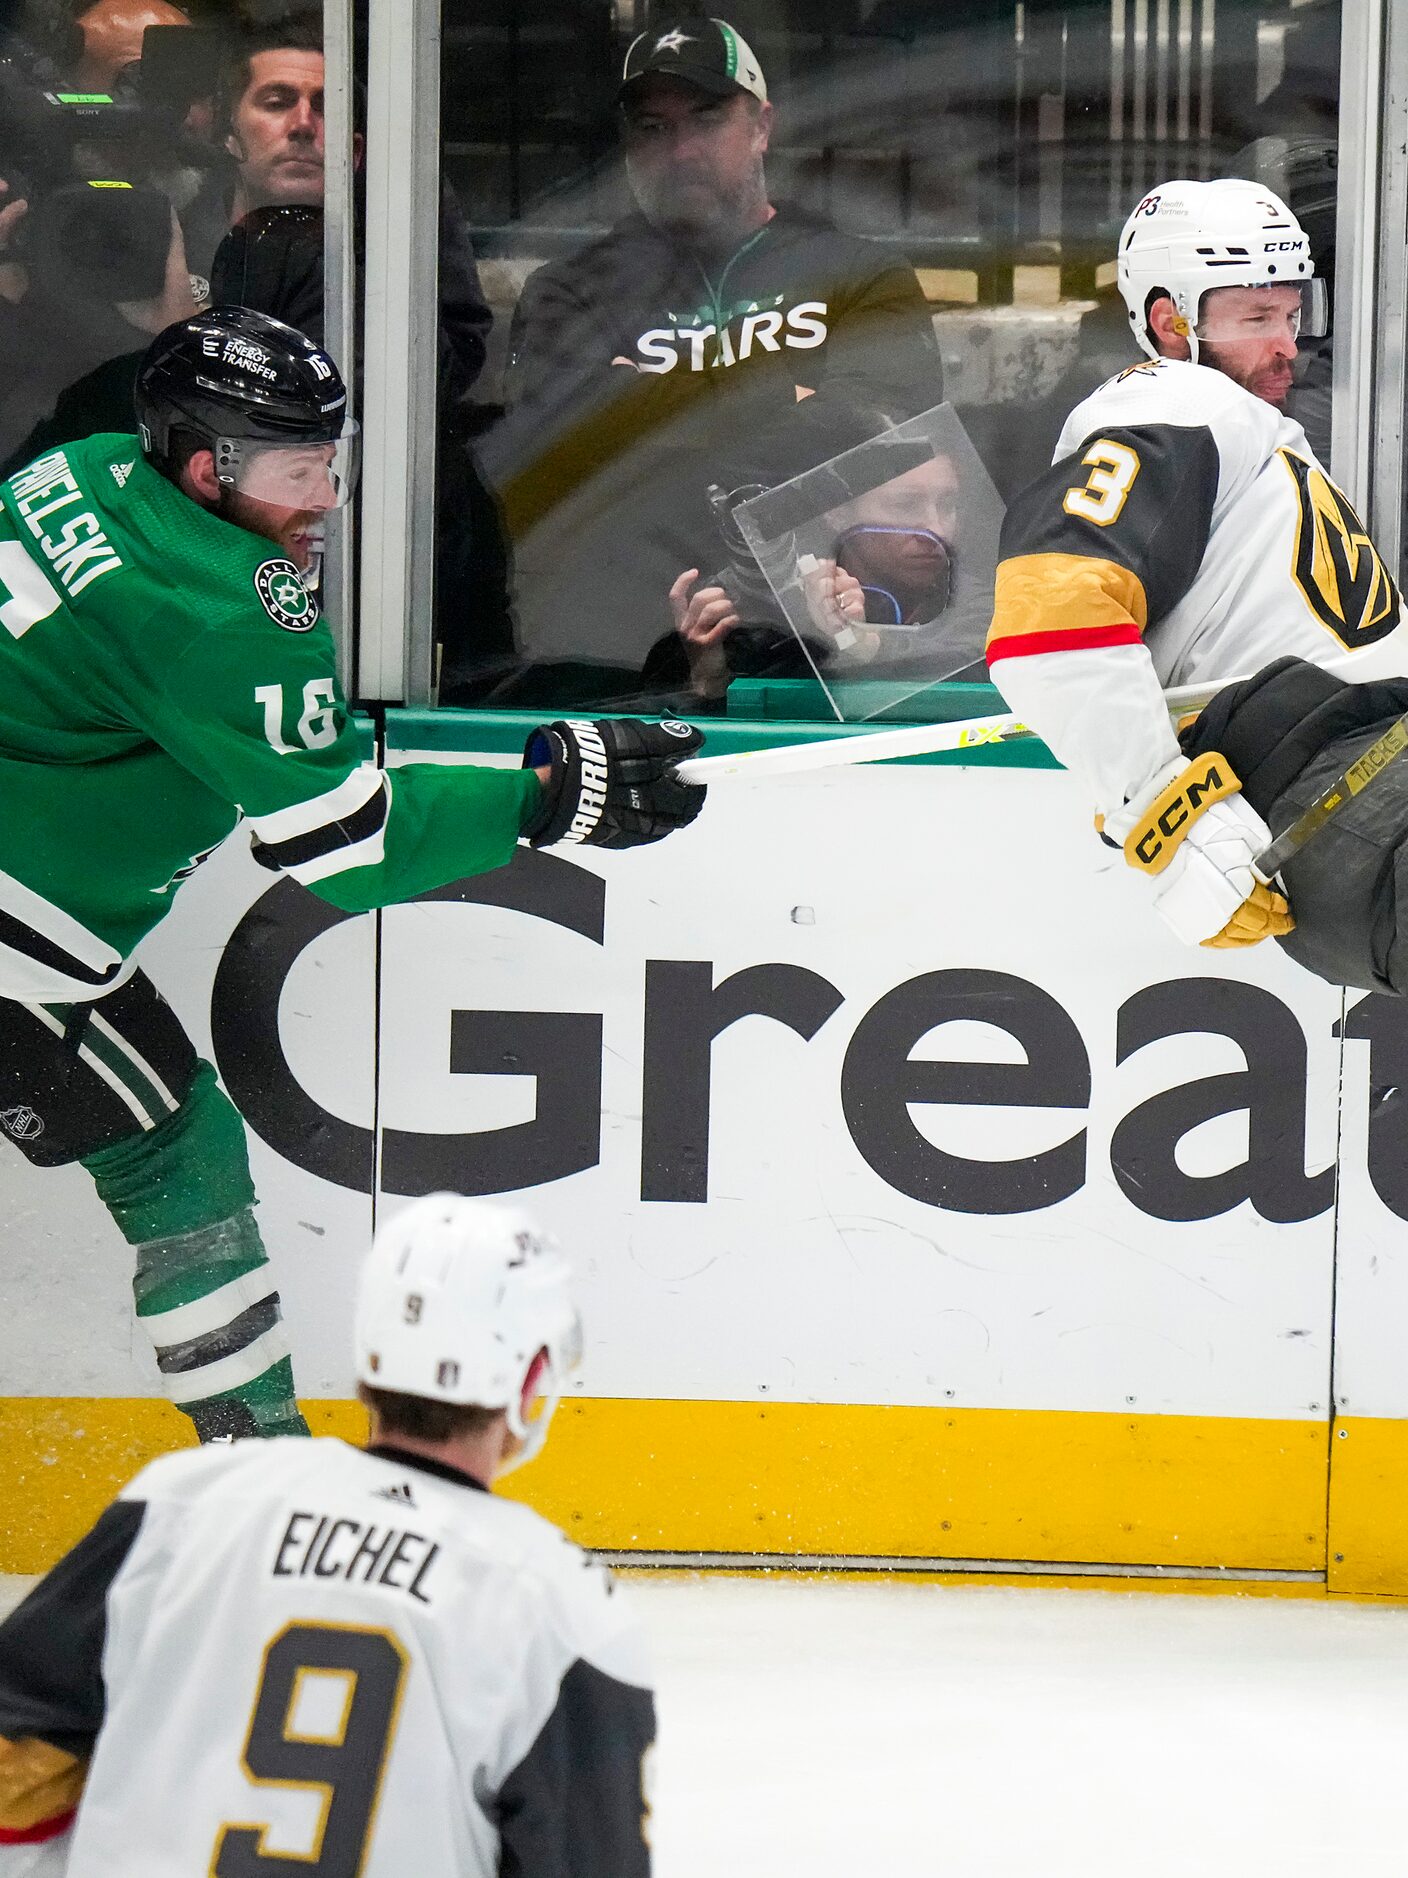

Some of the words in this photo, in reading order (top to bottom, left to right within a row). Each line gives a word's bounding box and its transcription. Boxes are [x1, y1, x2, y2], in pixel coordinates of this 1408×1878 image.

[1135, 195, 1162, 218] P3
[1157, 207, 1189, 216] Partners
[1159, 199, 1184, 209] Health
[1263, 240, 1303, 253] CCM
[223, 340, 271, 365] ENERGY
[637, 301, 828, 375] STARS
[221, 351, 278, 382] TRANSFER
[304, 353, 332, 381] 16
[1062, 438, 1141, 527] 3
[270, 603, 315, 627] STARS
[254, 677, 338, 756] 16
[1349, 732, 1402, 784] TACKS
[1135, 766, 1224, 865] CCM
[272, 1511, 443, 1605] EICHEL
[206, 1618, 412, 1878] 9
